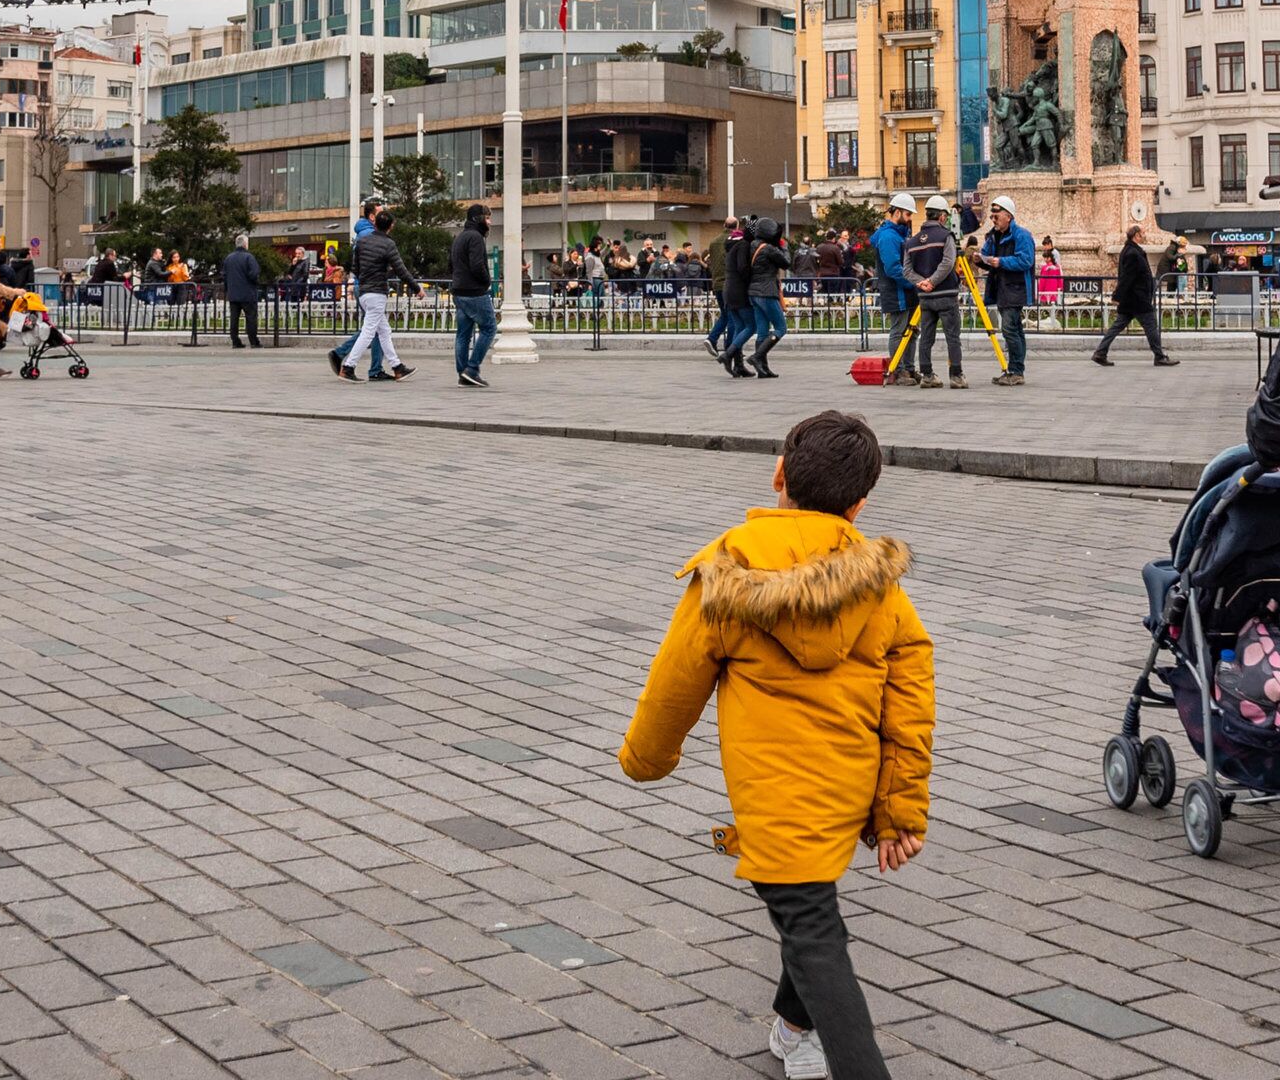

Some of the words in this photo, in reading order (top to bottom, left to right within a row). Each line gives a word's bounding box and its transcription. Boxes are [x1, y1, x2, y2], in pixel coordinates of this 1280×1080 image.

[634, 231, 667, 241] Garanti
[1219, 232, 1265, 241] watsons
[646, 281, 674, 294] POLİS
